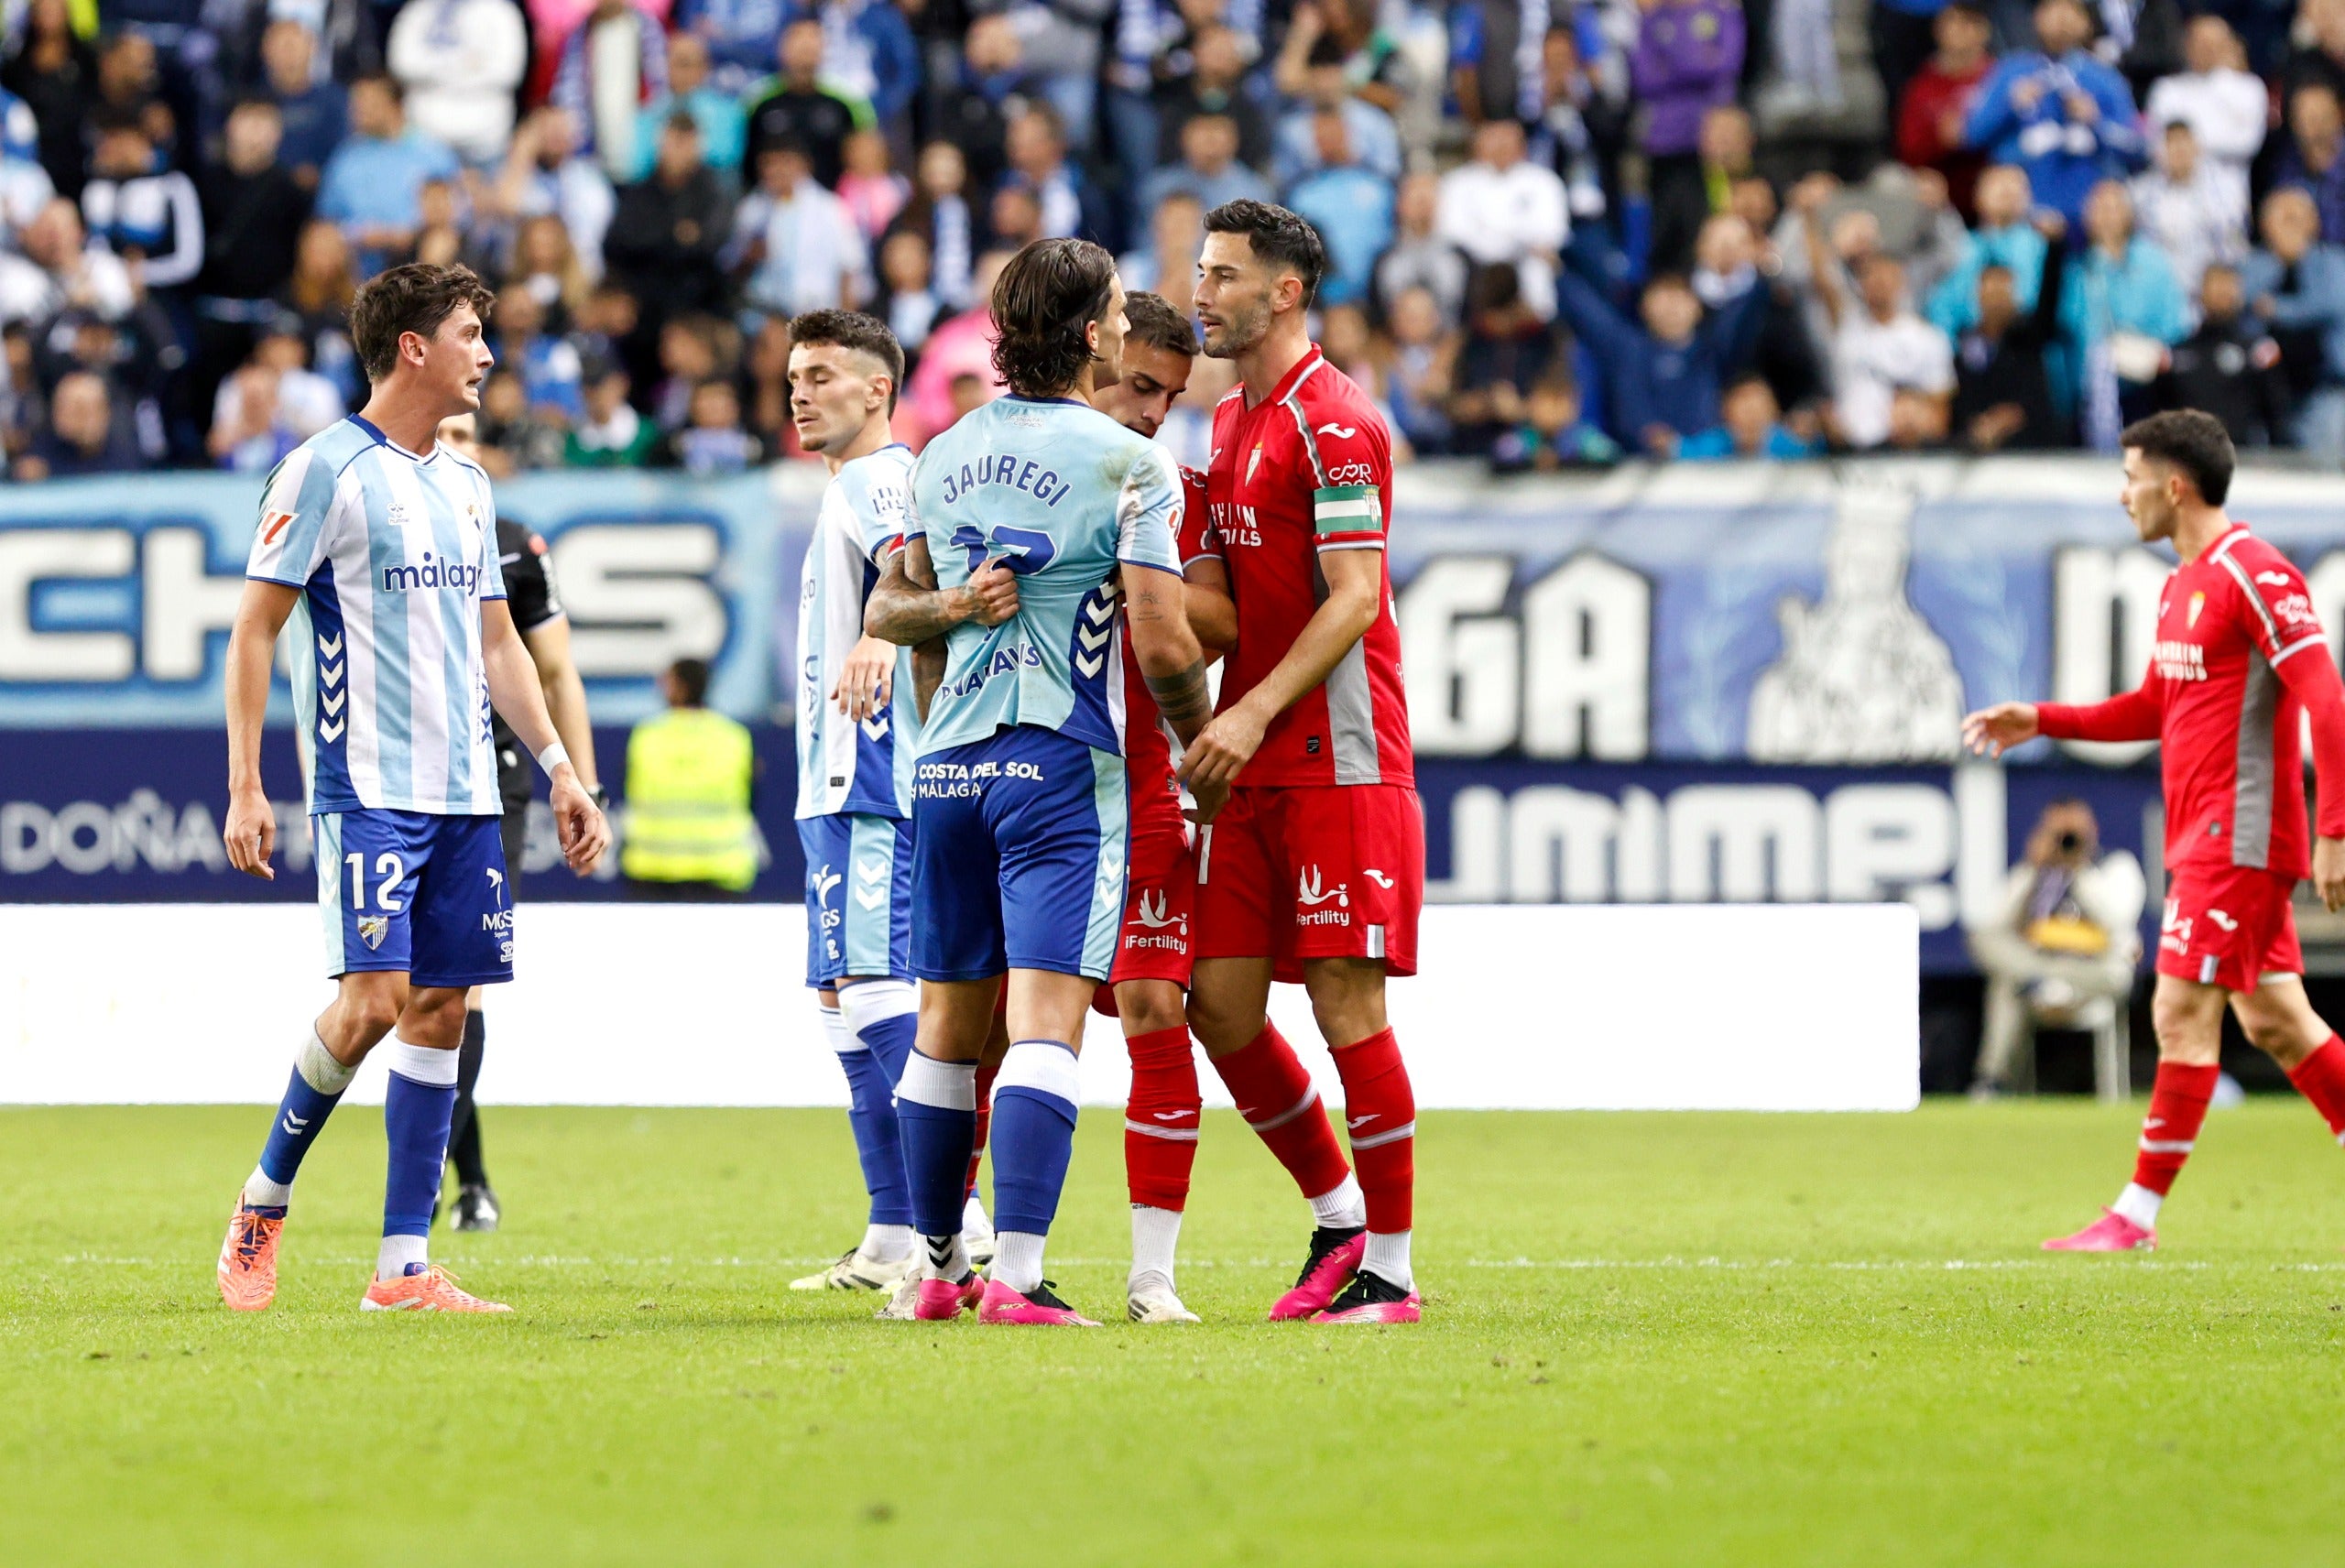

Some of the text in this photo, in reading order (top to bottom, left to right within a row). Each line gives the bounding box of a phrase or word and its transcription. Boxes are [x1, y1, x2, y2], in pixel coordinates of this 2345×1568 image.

[943, 454, 1072, 507] JAUREGI
[919, 761, 1044, 781] COSTA DEL SOL
[919, 779, 982, 799] MÁLAGA
[344, 852, 404, 911] 12
[482, 909, 514, 931] MGS
[821, 909, 841, 929] GS
[1125, 935, 1187, 955] iFertility
